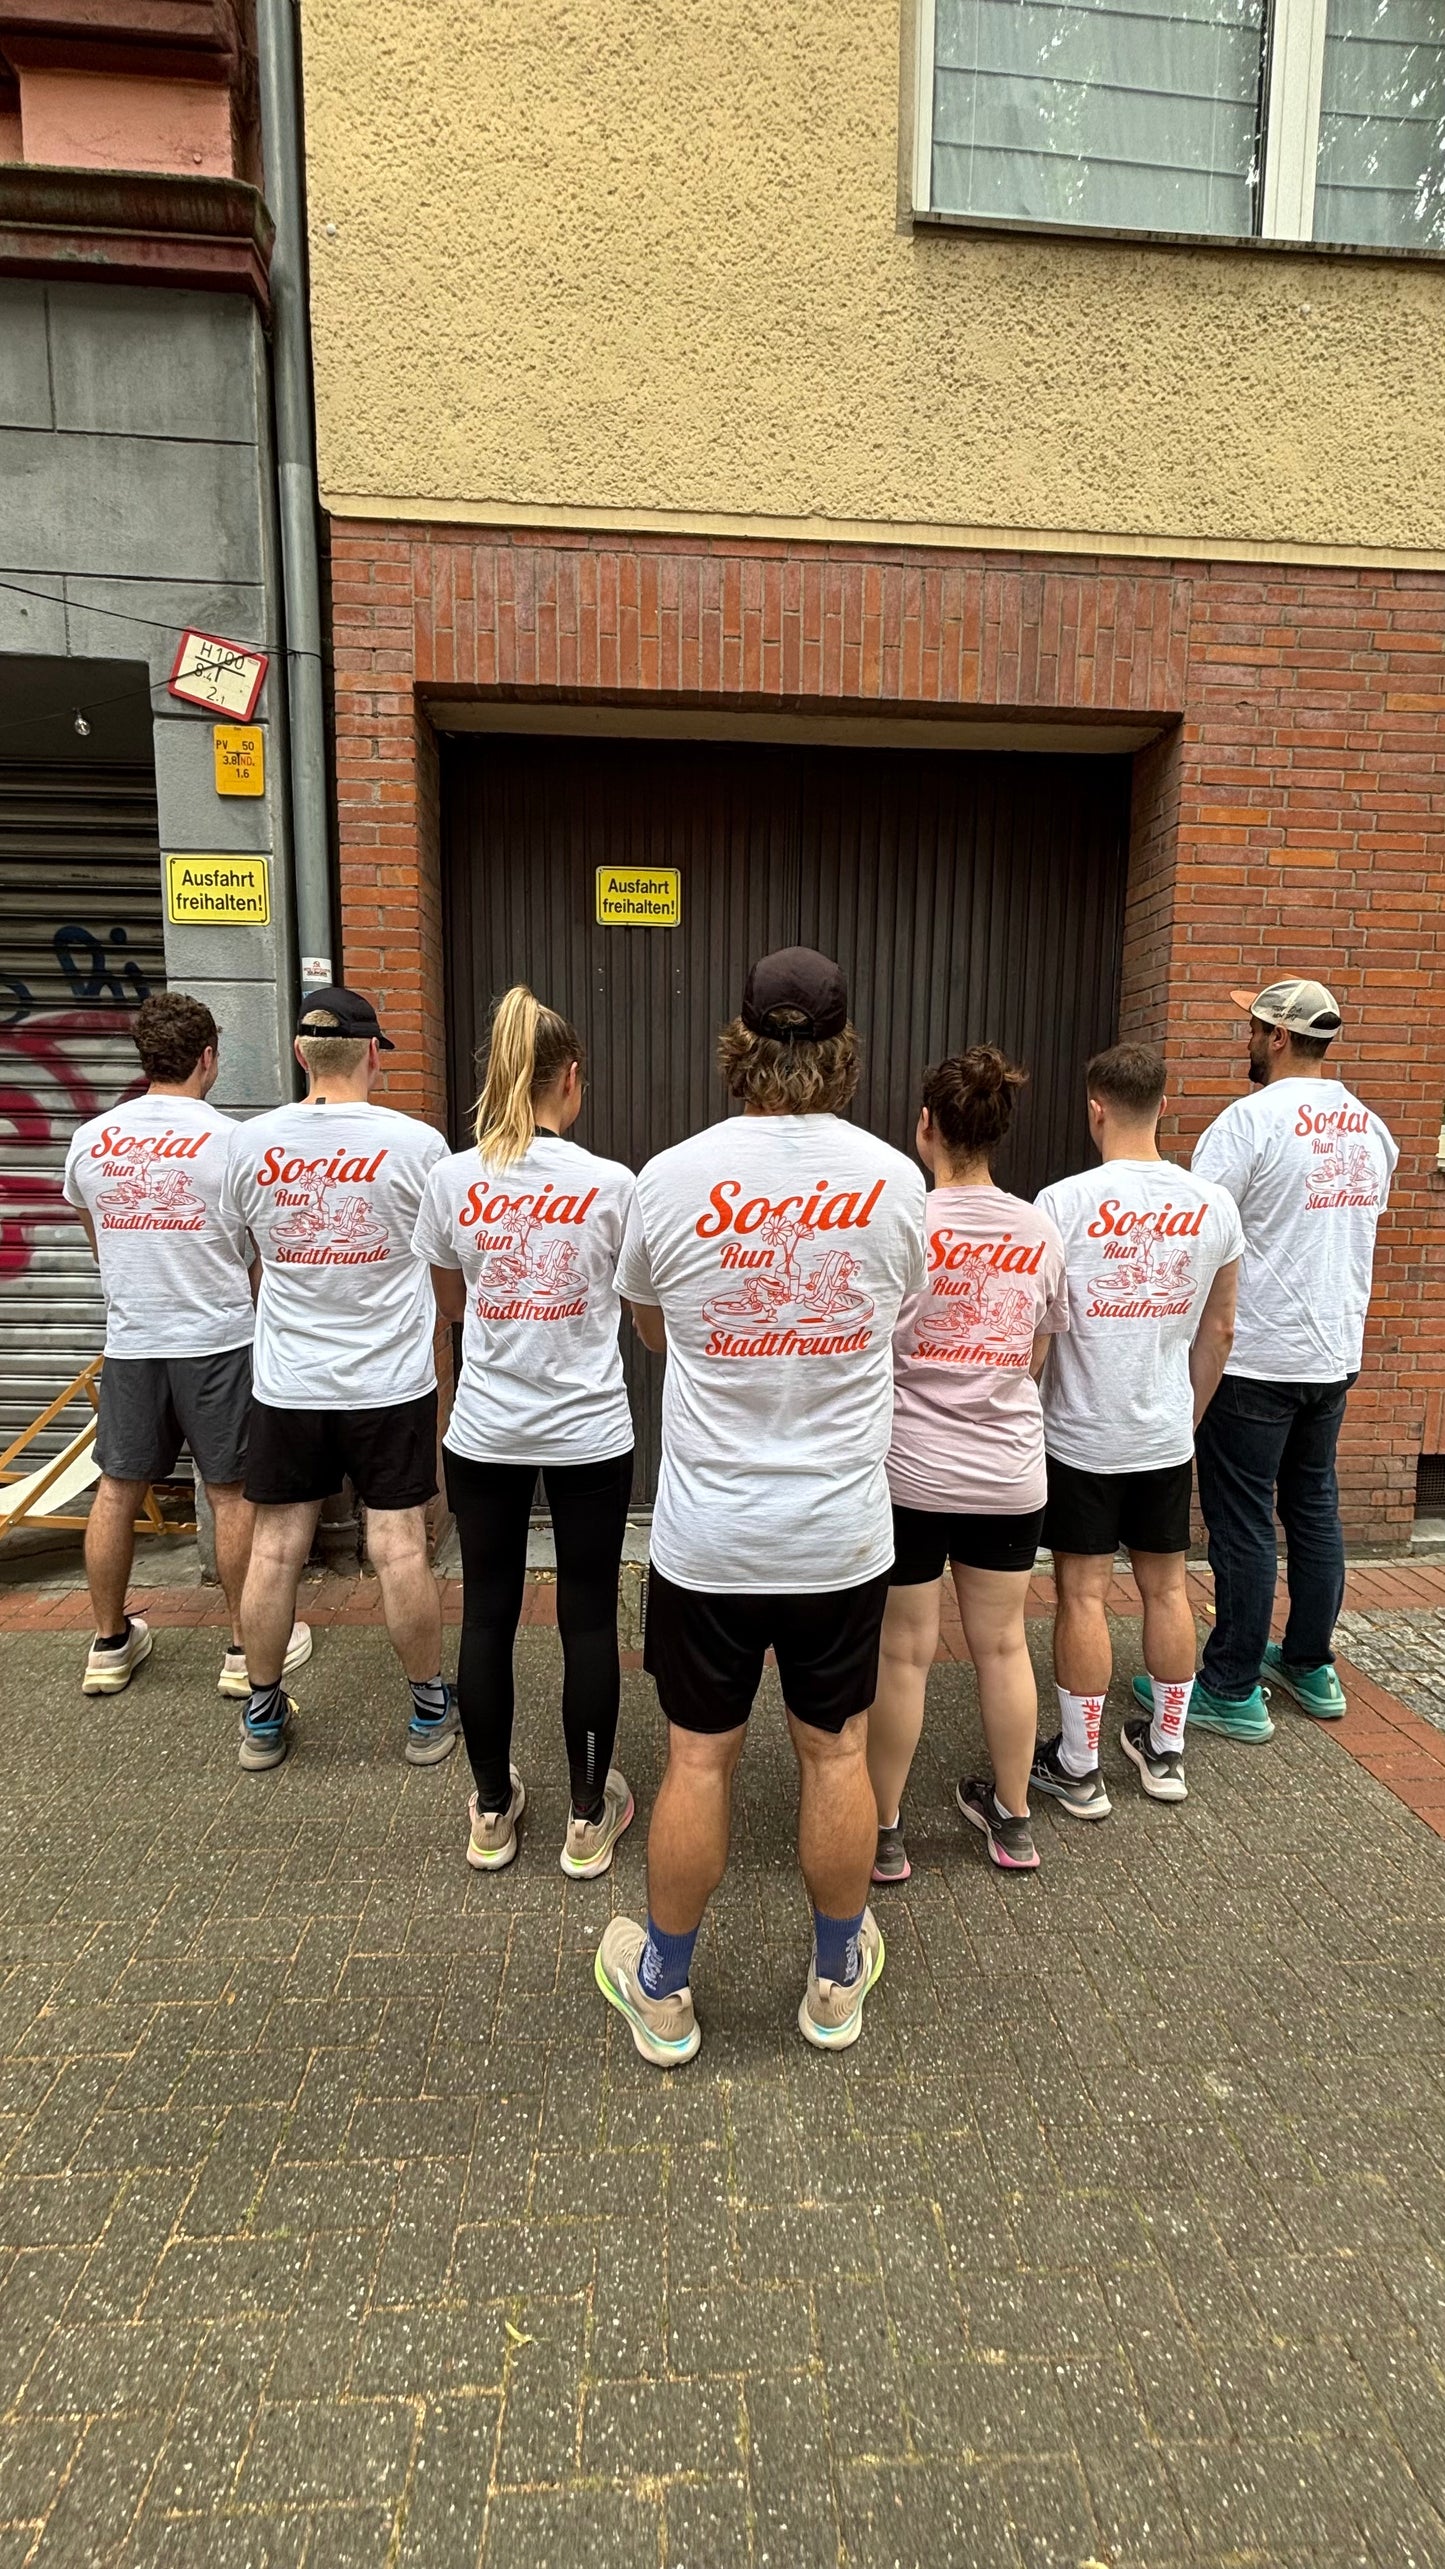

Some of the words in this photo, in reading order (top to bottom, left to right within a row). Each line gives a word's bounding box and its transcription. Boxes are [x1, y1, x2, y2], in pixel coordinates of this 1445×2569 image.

[206, 686, 225, 705] 2.1
[216, 740, 228, 750] PV
[242, 741, 255, 751] 50
[223, 755, 237, 765] 3.8
[236, 768, 250, 778] 1.6
[181, 869, 255, 887] Ausfahrt
[607, 878, 669, 894] Ausfahrt
[176, 892, 263, 911] freihalten!
[603, 898, 675, 915] freihalten!
[1295, 1102, 1369, 1137] Social
[90, 1126, 212, 1159] Social
[1311, 1138, 1334, 1155] Run
[102, 1161, 135, 1177] Run
[257, 1146, 389, 1187] Social
[275, 1188, 310, 1207] Run
[459, 1181, 600, 1227] Social
[695, 1179, 886, 1239] Social
[1087, 1199, 1209, 1238] Social
[101, 1213, 206, 1231] Stadtfreunde
[475, 1230, 513, 1250] Run
[275, 1245, 390, 1265] Stadtfreunde
[720, 1242, 775, 1269] Run
[927, 1228, 1046, 1275] Social
[1103, 1241, 1137, 1259] Run
[932, 1275, 971, 1296] Run
[476, 1297, 588, 1321] Stadtfreunde
[705, 1325, 872, 1357] Stadtfreunde
